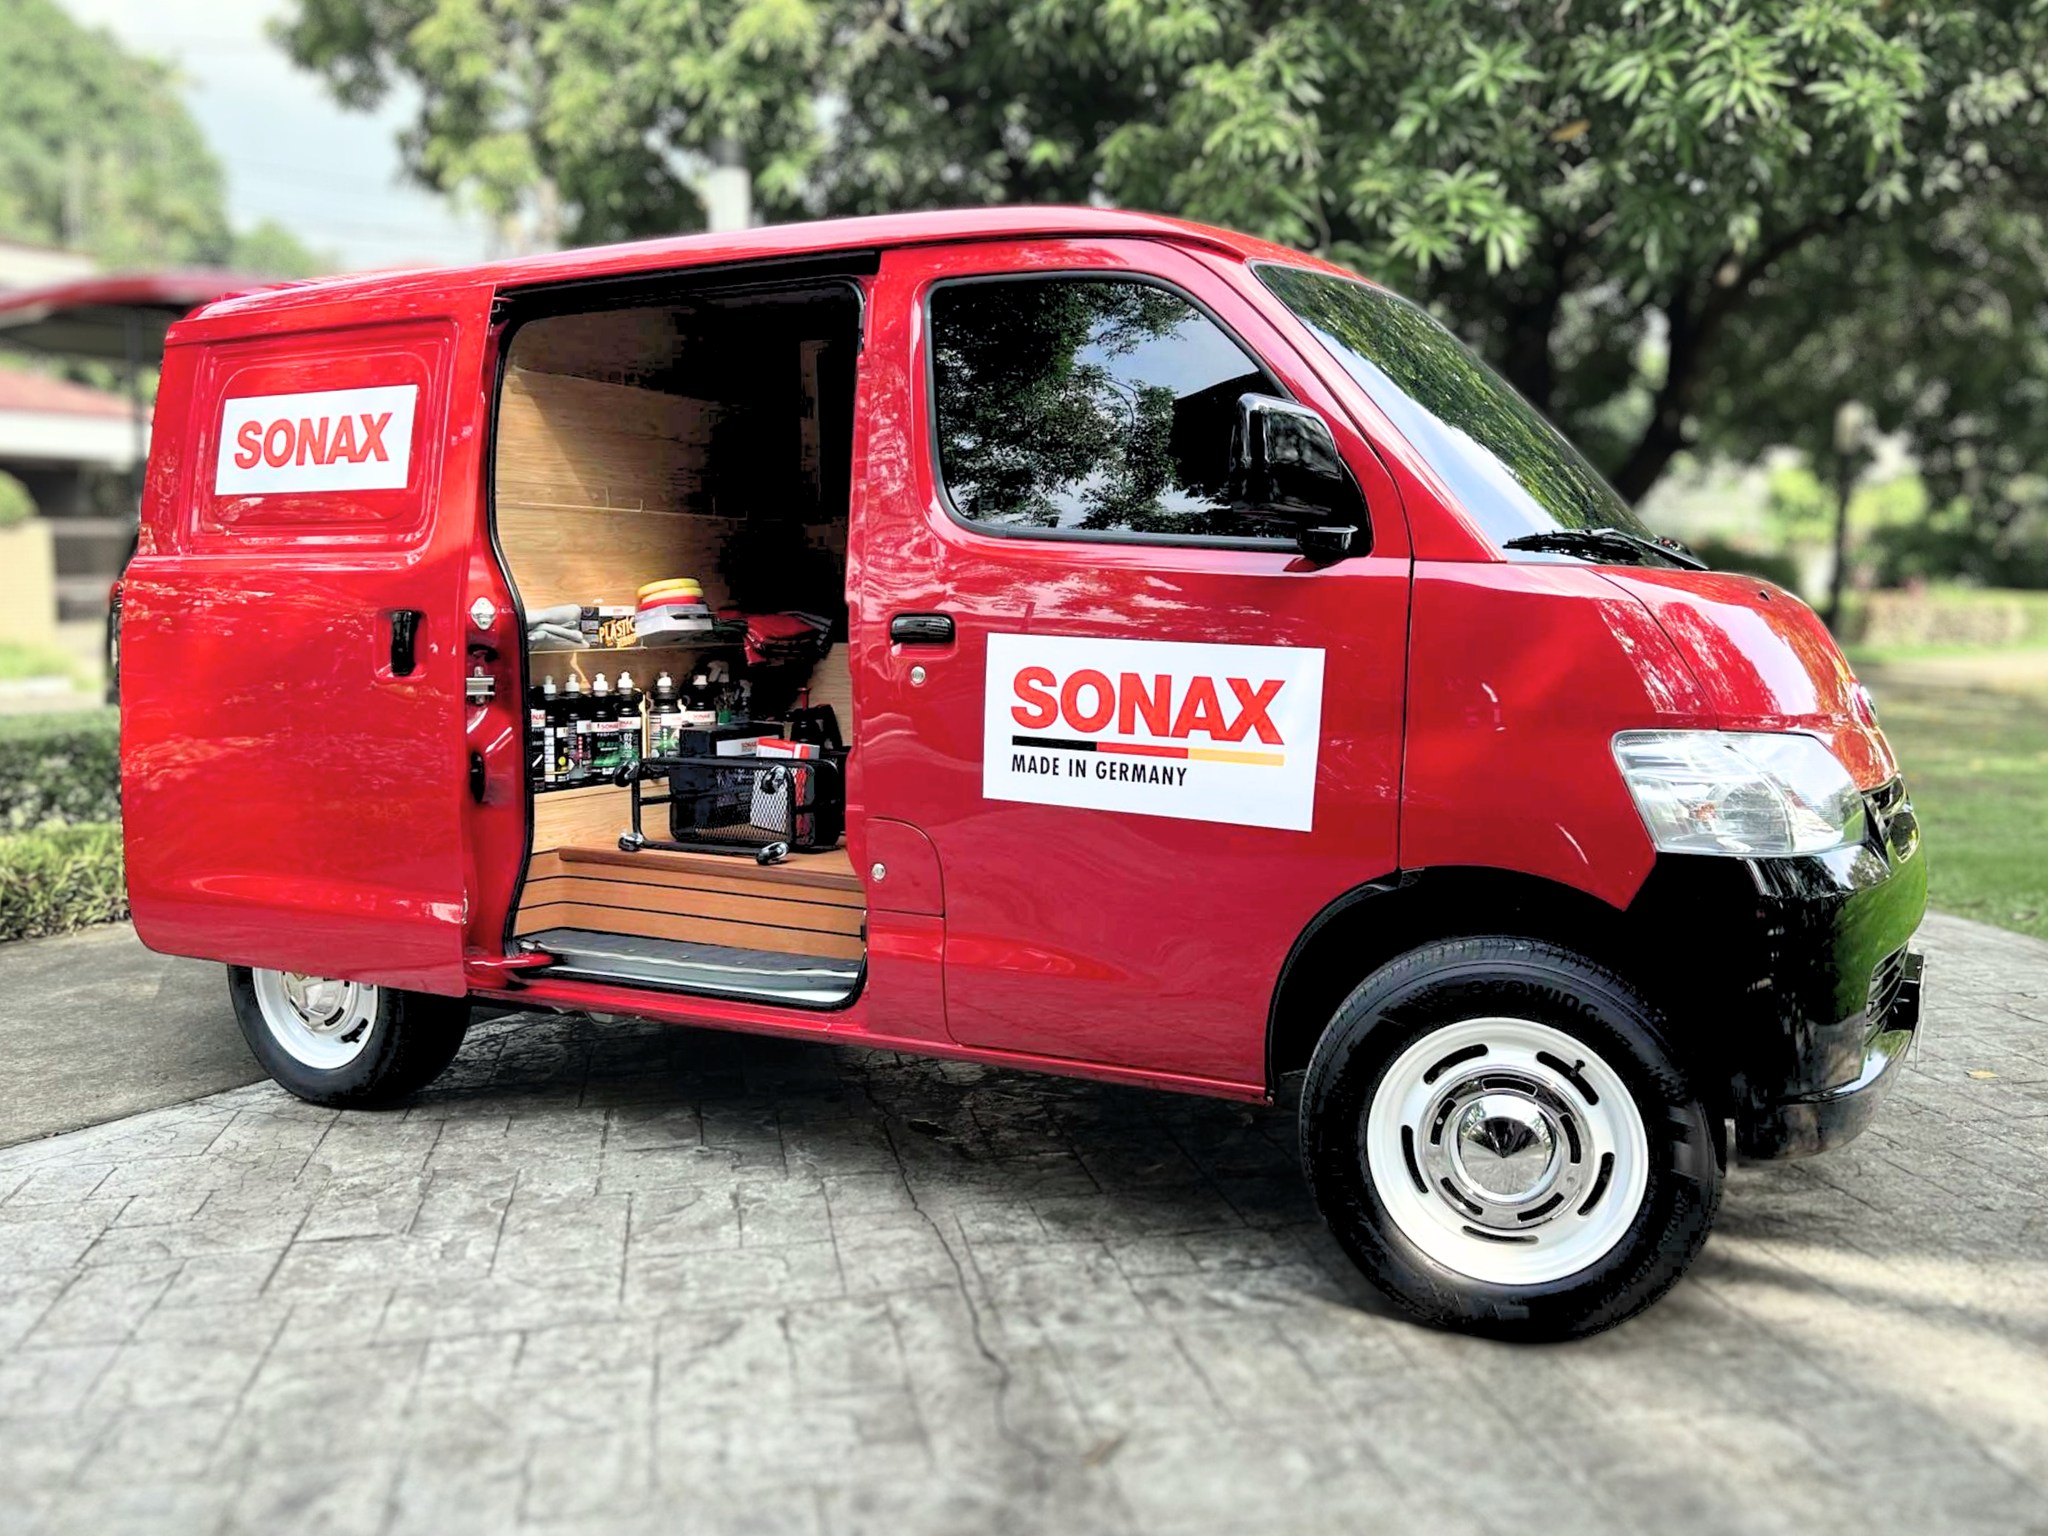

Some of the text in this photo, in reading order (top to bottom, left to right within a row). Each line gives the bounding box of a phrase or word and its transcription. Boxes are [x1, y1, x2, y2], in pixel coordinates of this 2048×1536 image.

[234, 412, 393, 469] SONAX
[599, 615, 635, 643] PLASTIC
[1010, 666, 1286, 745] SONAX
[1012, 754, 1188, 787] MADE IN GERMANY
